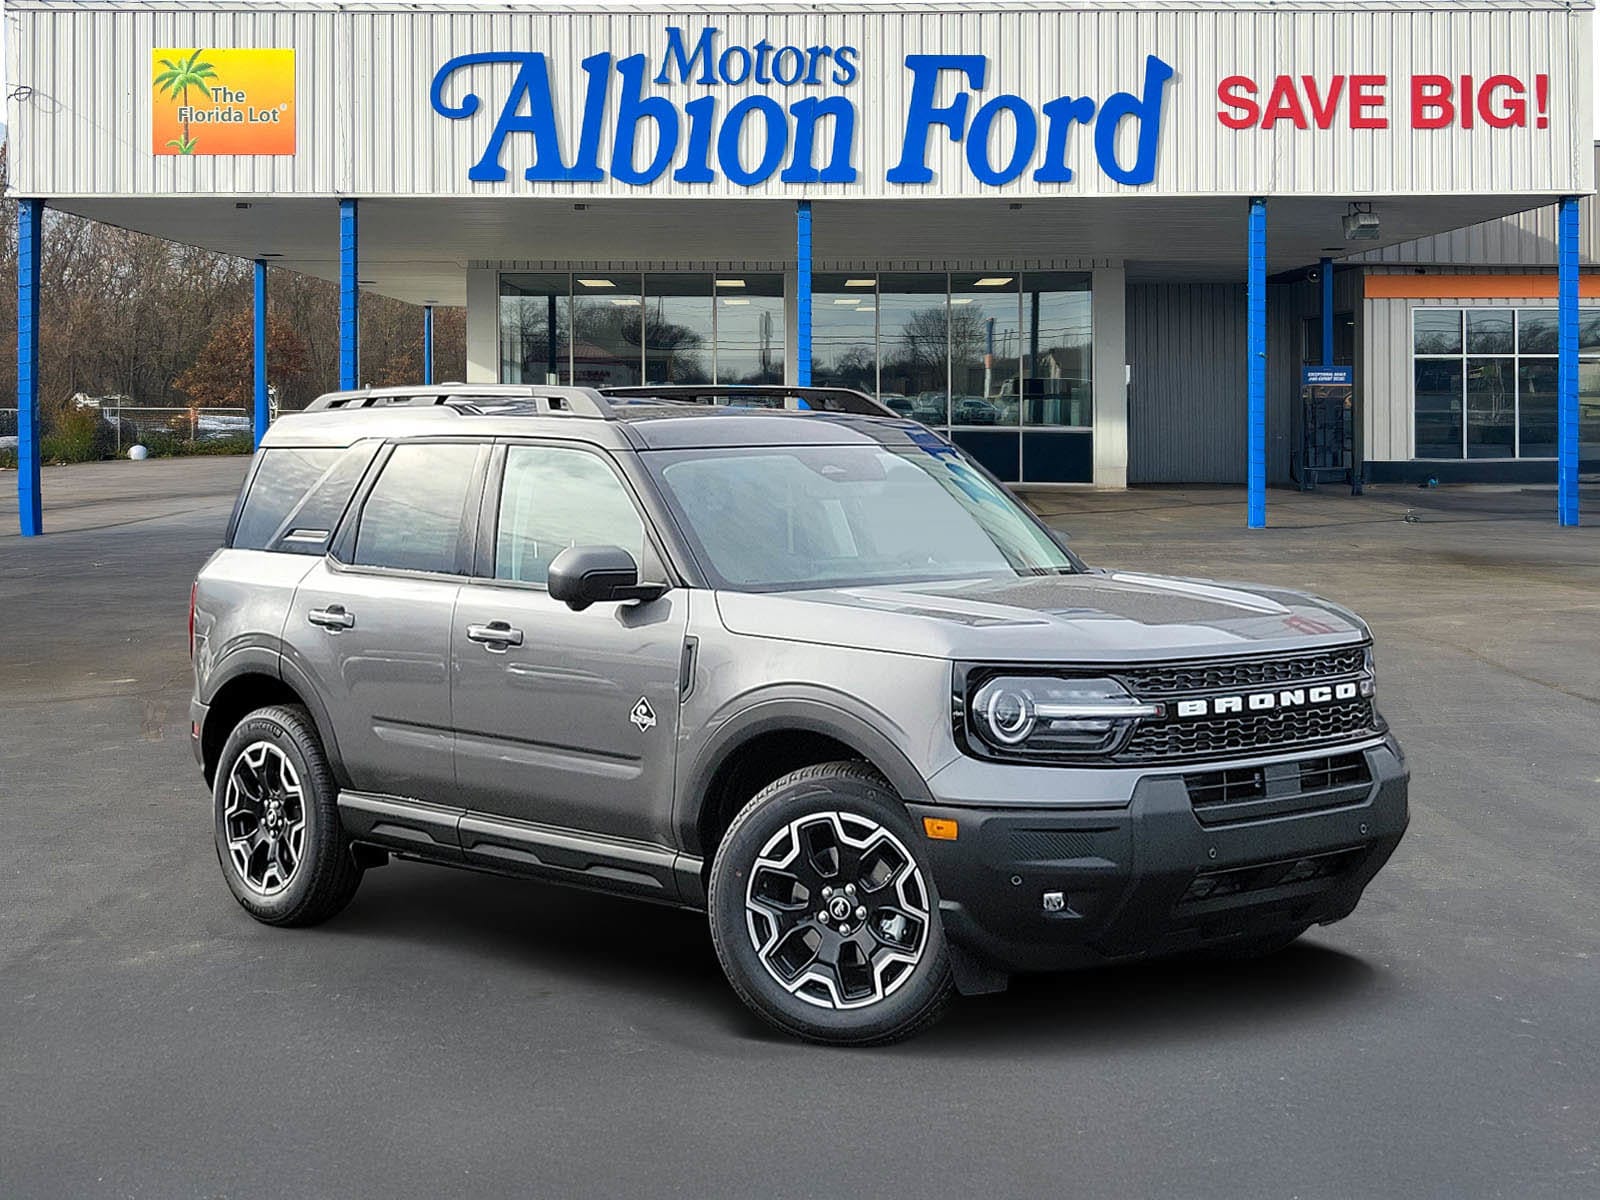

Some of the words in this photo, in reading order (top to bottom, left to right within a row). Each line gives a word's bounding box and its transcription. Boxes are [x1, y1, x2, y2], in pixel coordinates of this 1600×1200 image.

[655, 27, 857, 86] Motors
[178, 107, 243, 122] Florida
[249, 107, 279, 122] Lot
[211, 87, 246, 103] The
[1218, 75, 1387, 129] SAVE
[1411, 75, 1548, 129] BIG!
[430, 52, 857, 185] Albion
[886, 54, 1173, 184] Ford
[1177, 683, 1356, 717] BRONCO
